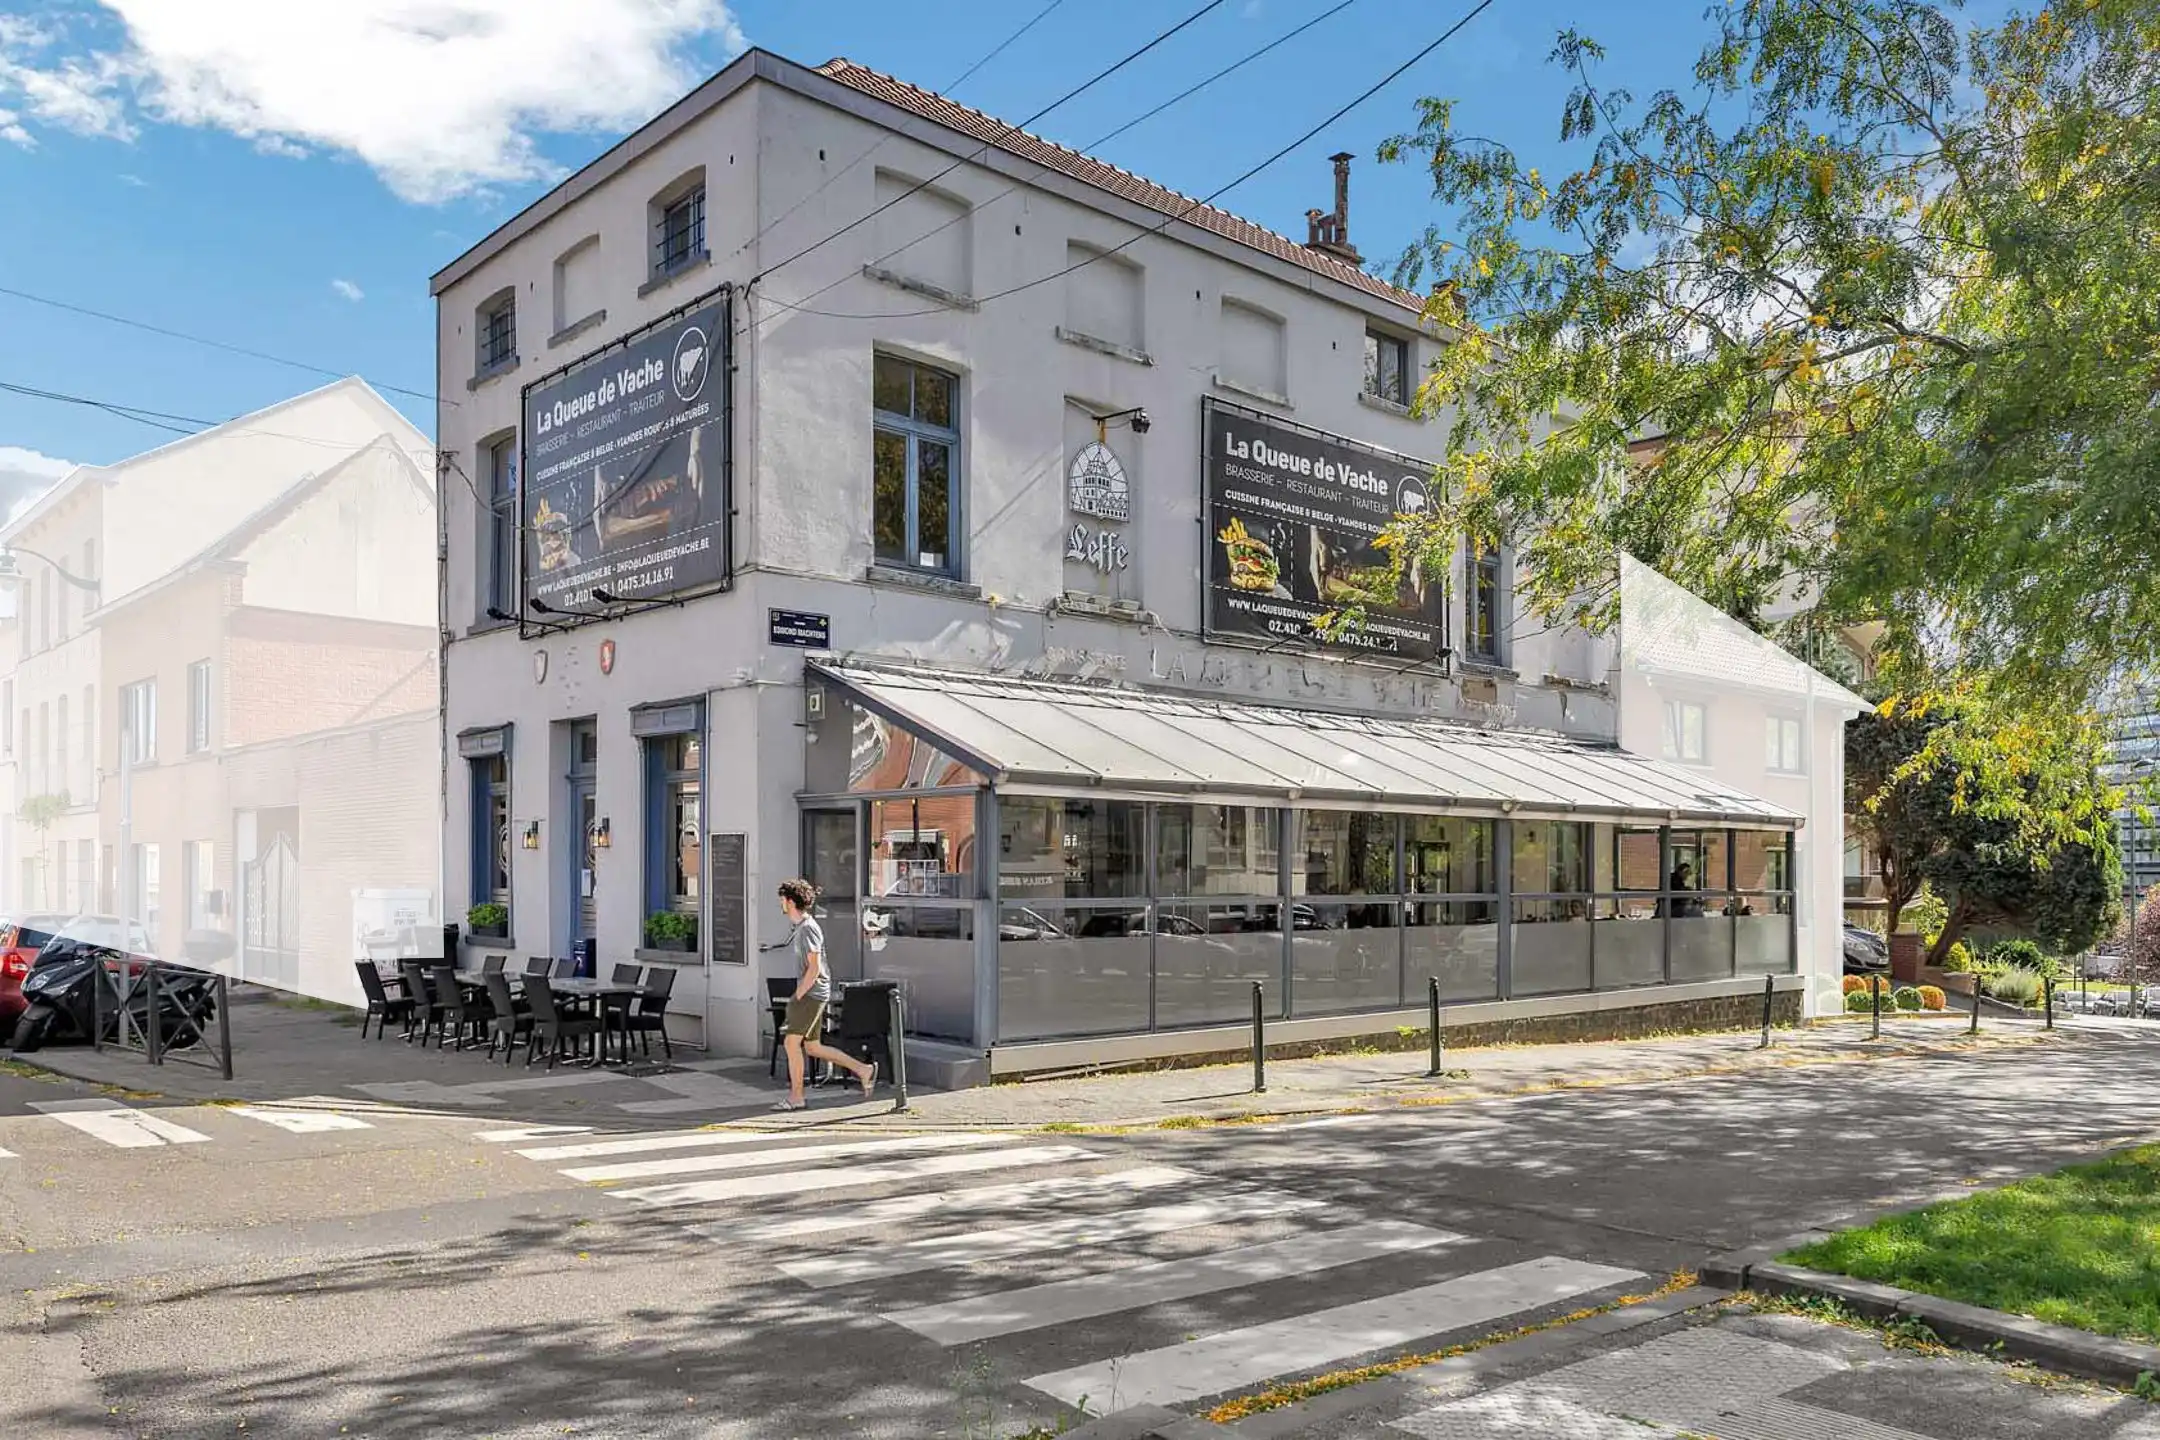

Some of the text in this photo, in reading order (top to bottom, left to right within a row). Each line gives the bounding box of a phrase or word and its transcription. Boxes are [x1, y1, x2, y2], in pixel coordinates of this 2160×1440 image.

[537, 358, 664, 434] La Queue de Vache
[576, 408, 621, 438] RESTAURANT
[629, 390, 664, 416] TRAITEUR
[595, 440, 614, 457] BELGE
[676, 402, 709, 425] MATURÉES
[1226, 432, 1388, 496] La Queue de Vache
[1225, 489, 1260, 505] CUISINE
[1261, 497, 1304, 516] FRANÇAISE
[1311, 510, 1335, 523] BELGE
[1226, 463, 1275, 486] BRASSERIE
[1286, 479, 1342, 503] RESTAURANT
[1352, 495, 1389, 514] TRAITEUR
[617, 537, 709, 573] INFO@LAQUEUEDEVACHE.BE
[1065, 518, 1111, 555] Leffe
[618, 566, 675, 593] 0475.24.16.91
